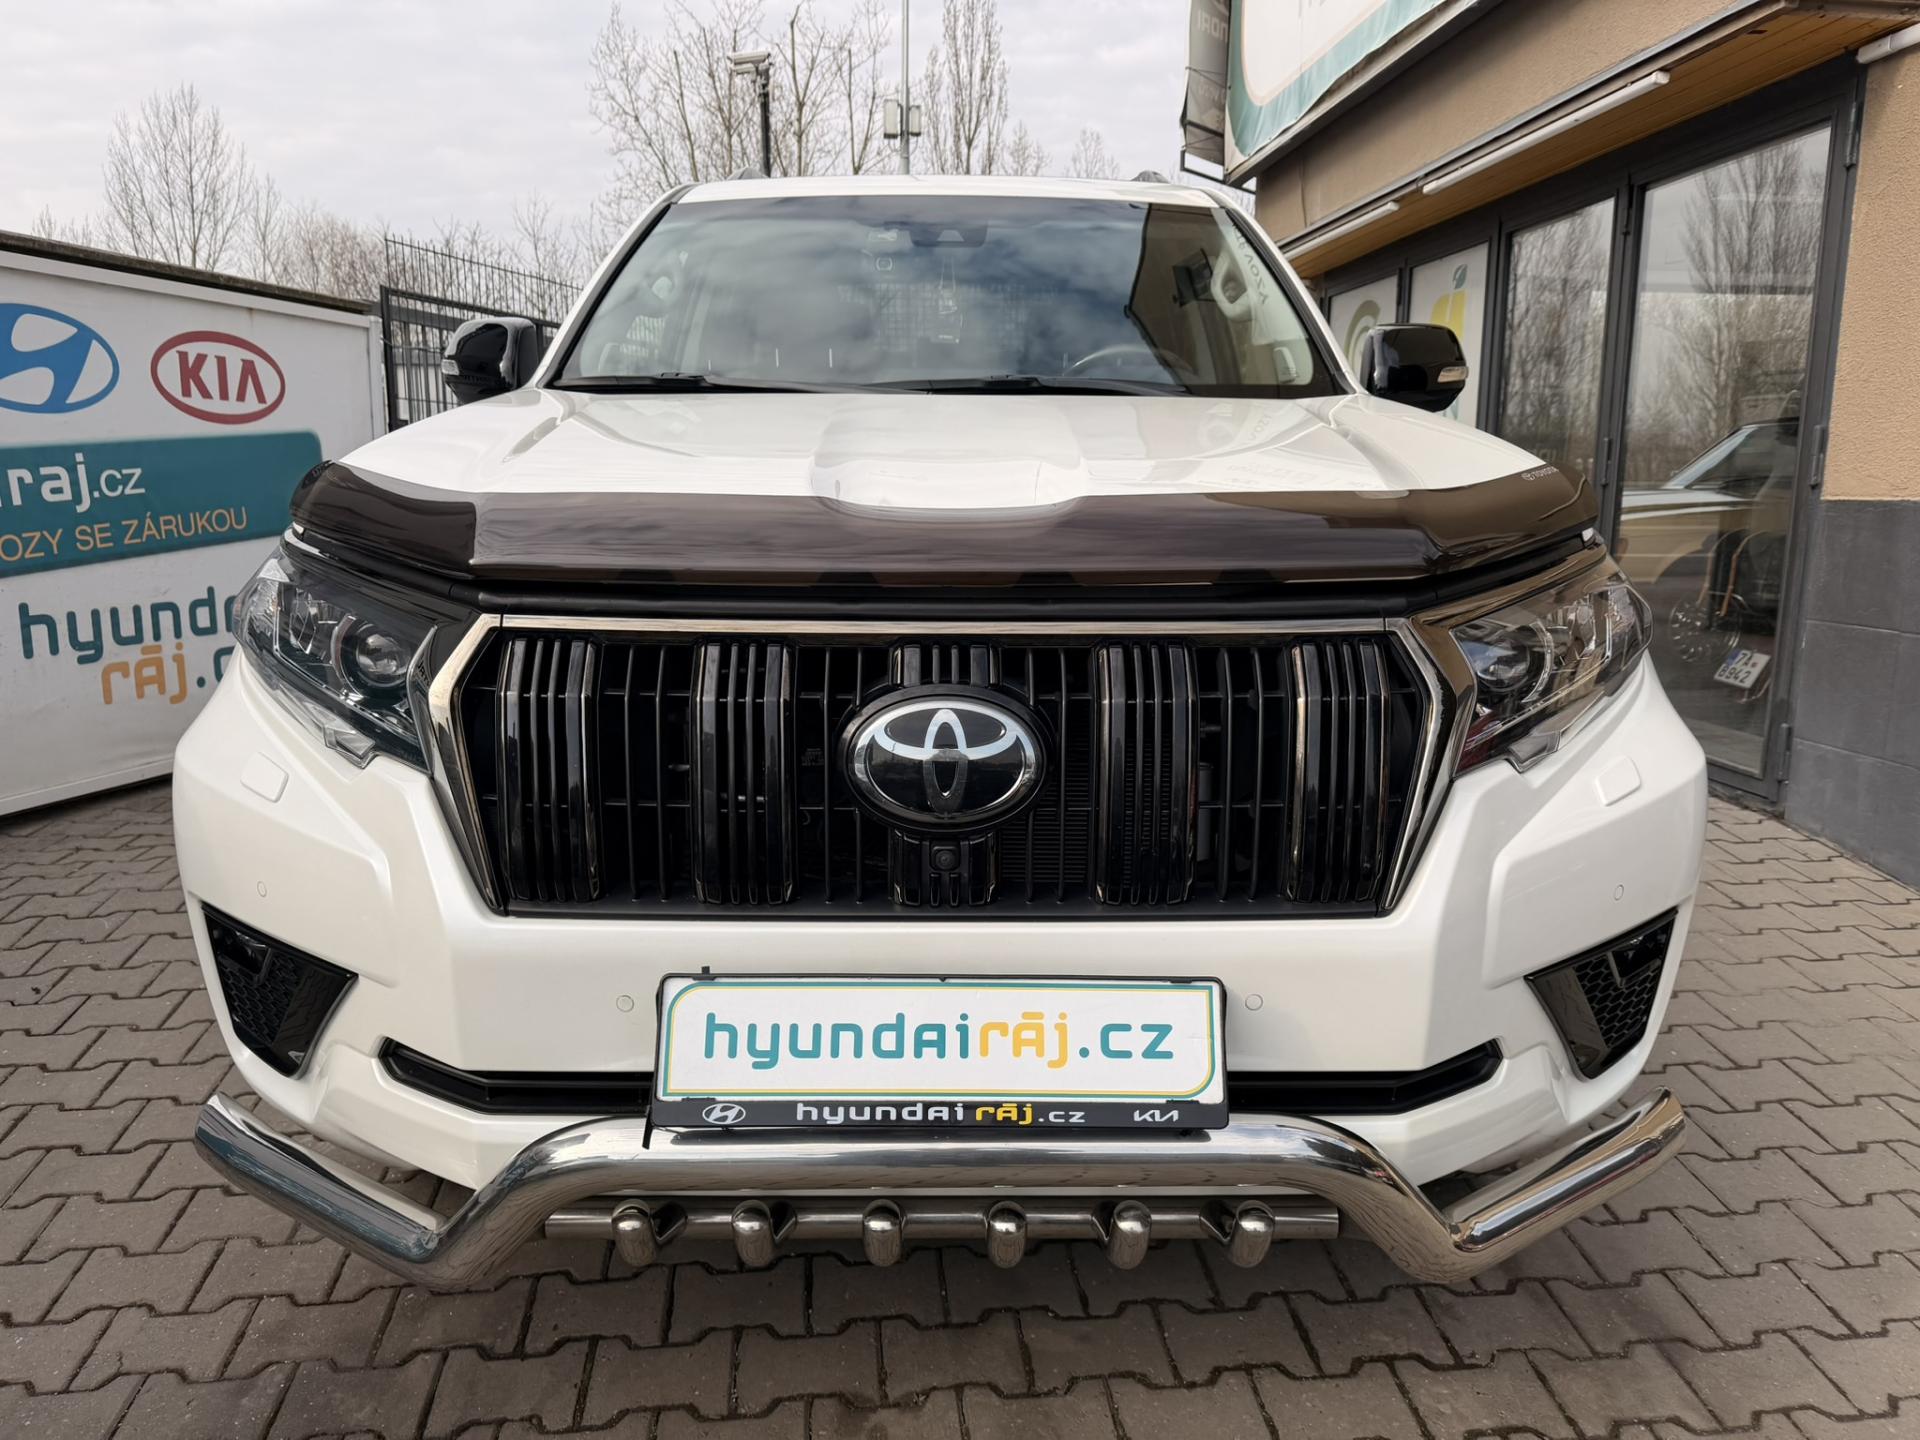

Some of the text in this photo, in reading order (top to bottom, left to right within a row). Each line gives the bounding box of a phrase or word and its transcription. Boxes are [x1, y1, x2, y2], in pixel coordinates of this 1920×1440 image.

[176, 350, 267, 404] KIA
[0, 452, 146, 513] raj.cz
[0, 505, 248, 562] OZY SE ZÁRUKOU
